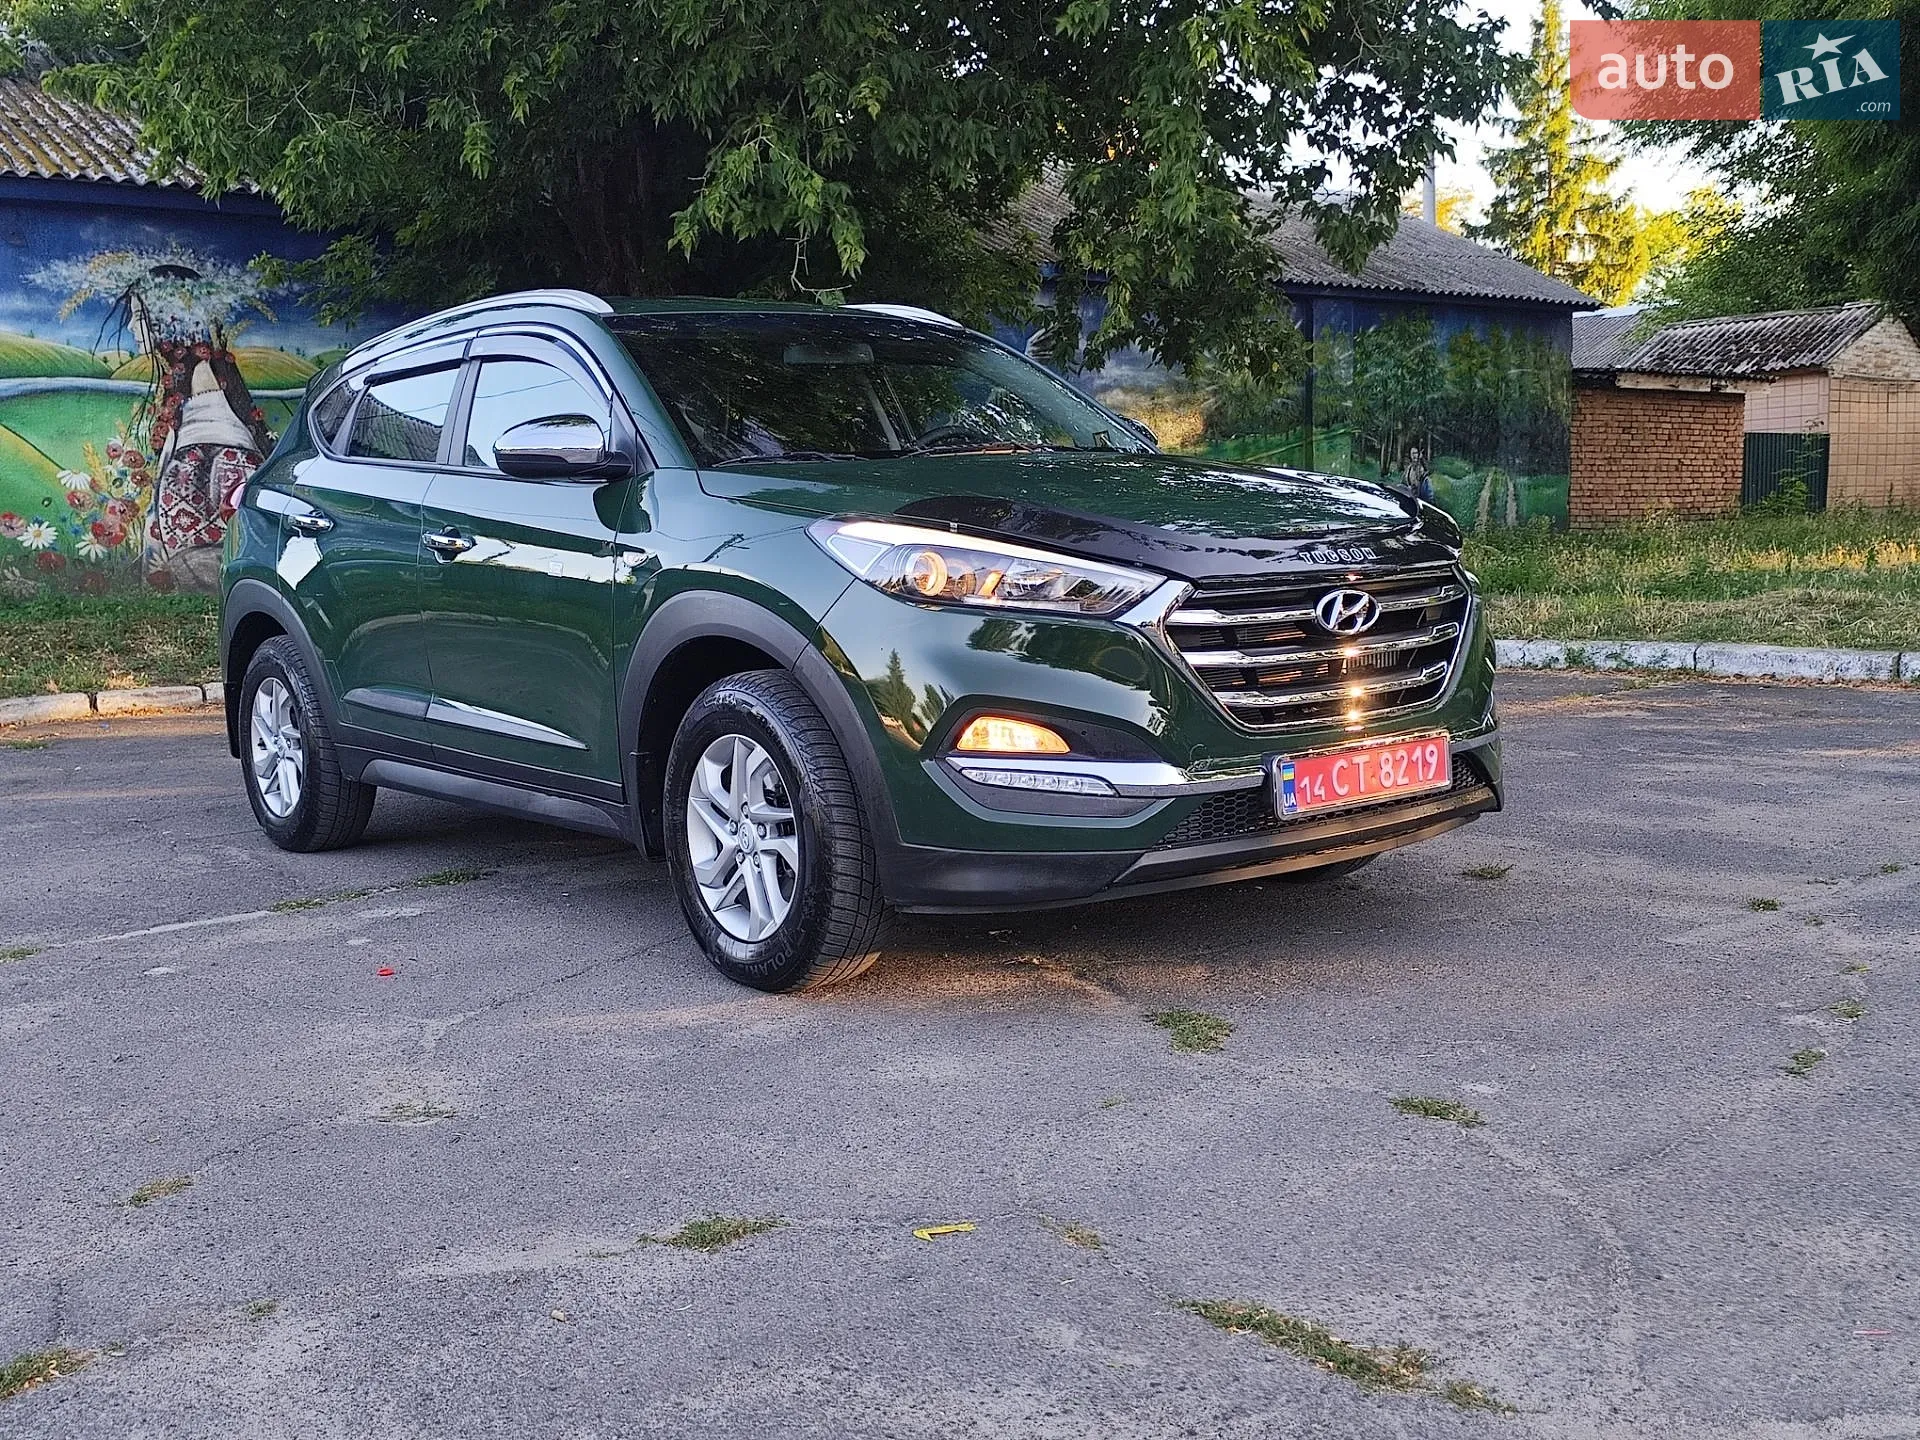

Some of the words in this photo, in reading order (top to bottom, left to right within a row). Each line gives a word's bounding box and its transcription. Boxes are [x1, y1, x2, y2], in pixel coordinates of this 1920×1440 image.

[1299, 547, 1377, 565] TUCSON
[1300, 772, 1326, 804] 14
[1379, 743, 1439, 788] 8219
[1283, 793, 1297, 807] UA
